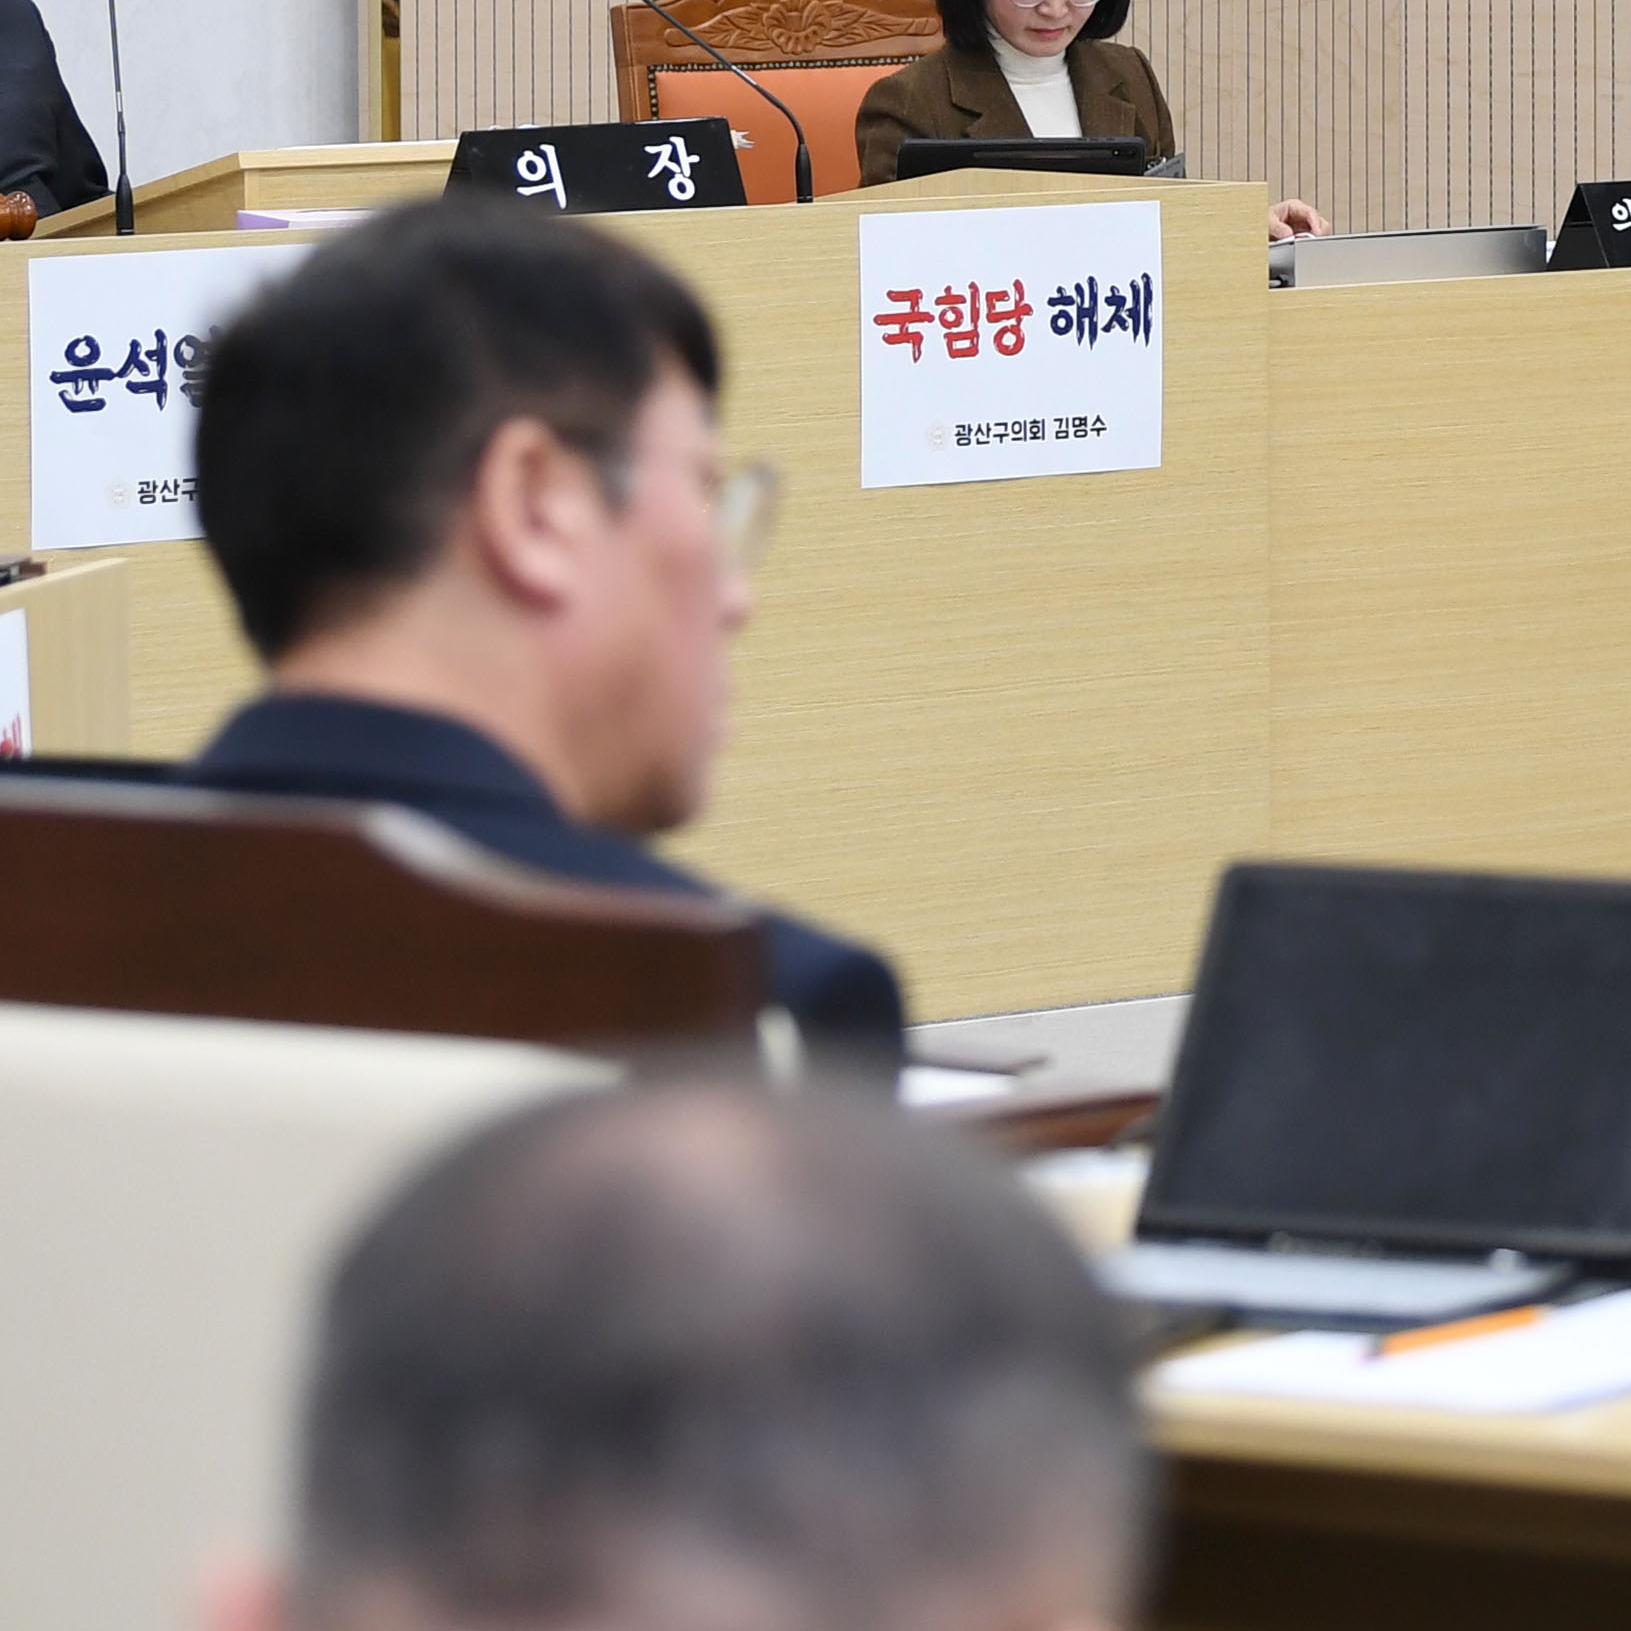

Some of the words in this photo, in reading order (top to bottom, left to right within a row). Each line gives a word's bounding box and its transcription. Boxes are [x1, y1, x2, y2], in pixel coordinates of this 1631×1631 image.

[872, 278, 1034, 364] 국힘당
[1046, 272, 1152, 351] 해체
[954, 418, 1046, 447] 광산구의회
[1053, 414, 1107, 440] 김명수
